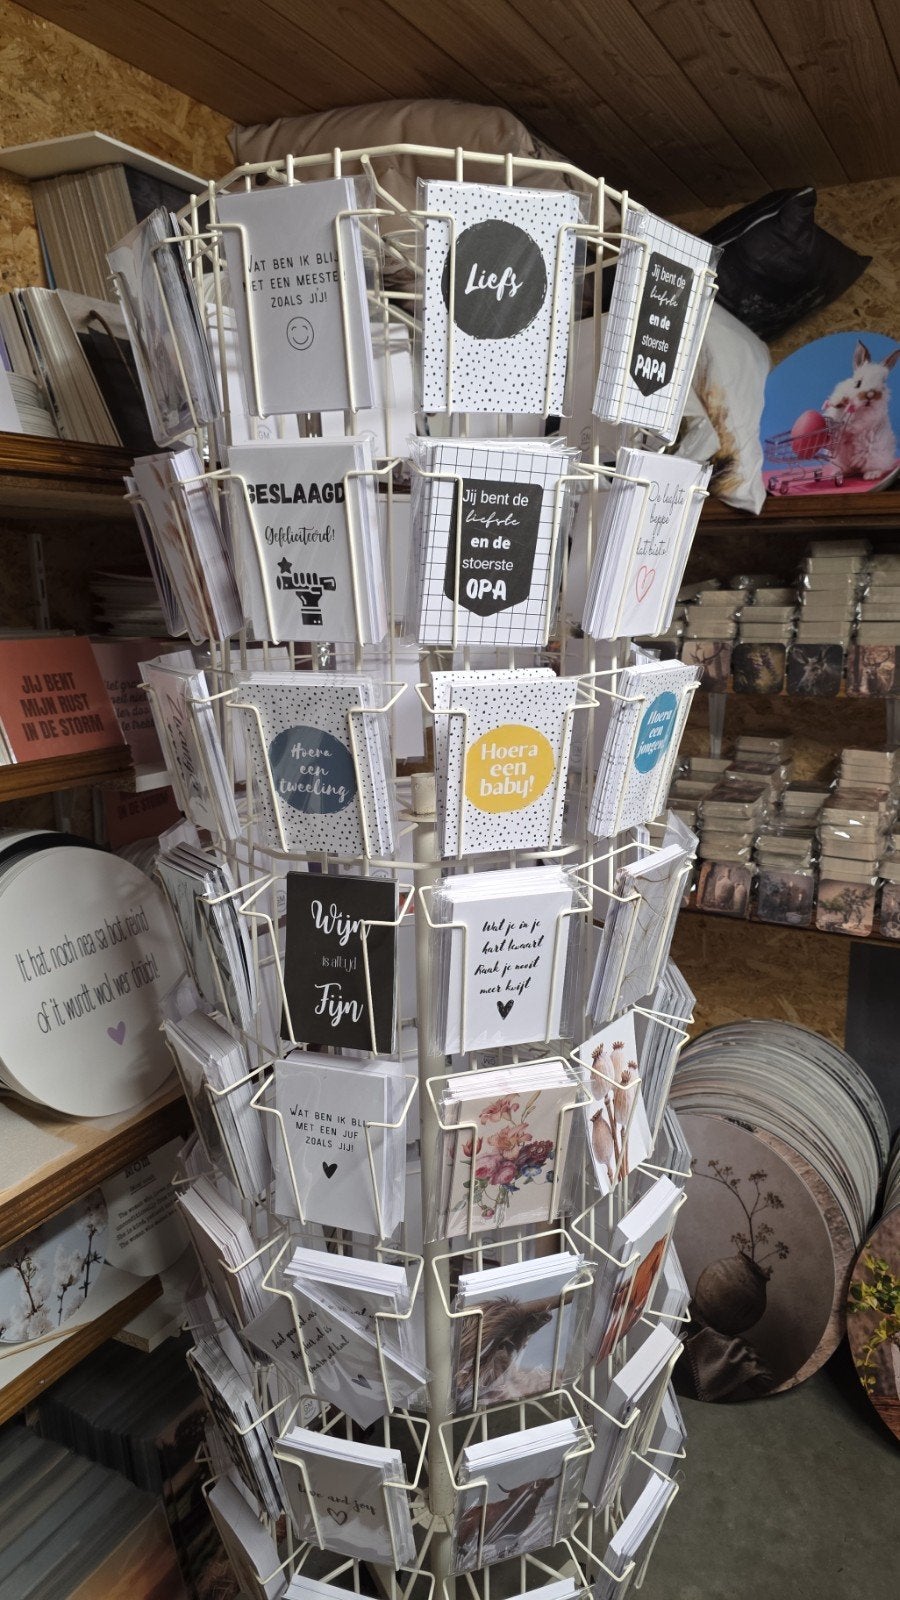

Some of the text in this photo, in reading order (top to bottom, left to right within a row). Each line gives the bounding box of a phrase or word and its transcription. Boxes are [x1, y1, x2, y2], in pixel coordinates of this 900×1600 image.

[273, 257, 293, 269] BEN
[300, 255, 309, 266] IK
[243, 270, 345, 292] ET EEN MEESTE
[465, 263, 523, 301] Liefs
[652, 264, 686, 289] Jij bent de
[271, 295, 302, 308] ZOALS
[650, 285, 678, 306] liefste
[649, 314, 670, 330] en de
[642, 334, 668, 352] stoerste
[634, 354, 666, 384] PAPA
[462, 490, 528, 506] Jij bent de
[466, 510, 520, 528] liefste
[265, 525, 335, 547] Gefeliciteerd!
[471, 536, 511, 549] en de
[462, 558, 513, 571] stoerste
[466, 579, 506, 600] OPA
[22, 672, 76, 694] JIJ BENT
[20, 697, 58, 718] MIJN
[59, 694, 91, 712] RUST
[648, 710, 672, 725] Hoera
[22, 714, 104, 741] IN DE STORM
[649, 726, 663, 738] een
[291, 742, 332, 759] Hoera
[481, 743, 538, 760] Hoera
[300, 766, 329, 776] een
[490, 762, 527, 776] een
[280, 778, 349, 803] tweeling
[480, 775, 535, 798] baby!
[311, 900, 371, 946] Wijn
[483, 919, 540, 936] Wat je in je
[15, 954, 32, 982] It
[27, 946, 51, 977] hat
[50, 935, 78, 969] noch
[77, 934, 96, 957] nea
[104, 916, 127, 945] bot
[482, 939, 506, 954] hart
[474, 956, 540, 977] Raak je nooit
[480, 977, 531, 995] meer kwijt
[37, 1002, 51, 1033] of
[93, 973, 115, 1005] wol
[315, 983, 363, 1026] Fijn
[290, 1104, 308, 1117] WAT
[315, 1112, 332, 1121] BEN
[338, 1116, 345, 1124] IK
[296, 1122, 358, 1139] MET EEN JUF
[306, 1136, 354, 1152] ZOALS JIJ!
